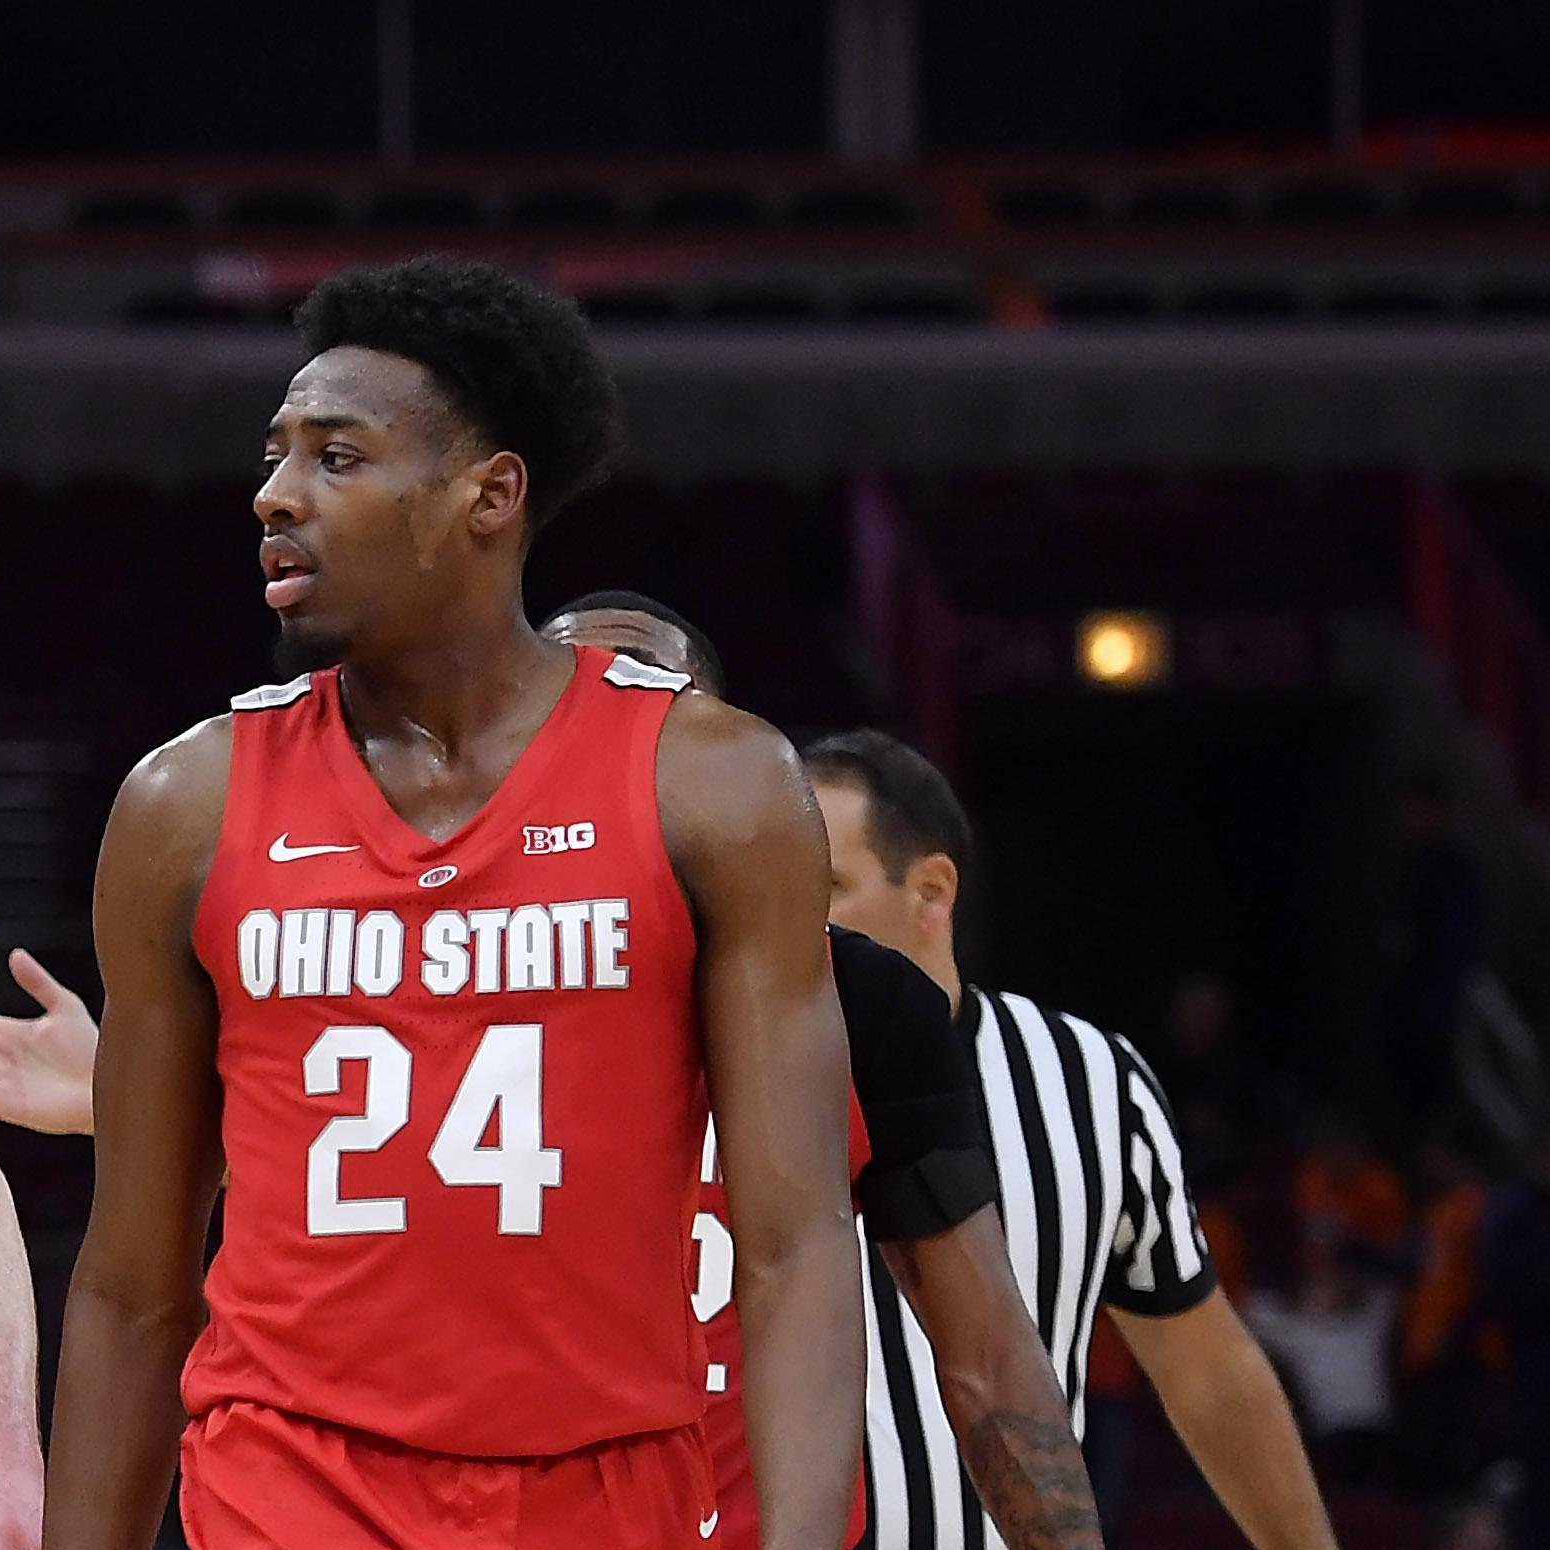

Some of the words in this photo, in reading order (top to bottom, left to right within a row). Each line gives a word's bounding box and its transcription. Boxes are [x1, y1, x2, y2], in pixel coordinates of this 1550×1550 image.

[237, 908, 404, 999] OHIO
[421, 898, 629, 995] STATE
[303, 1024, 563, 1235] 24
